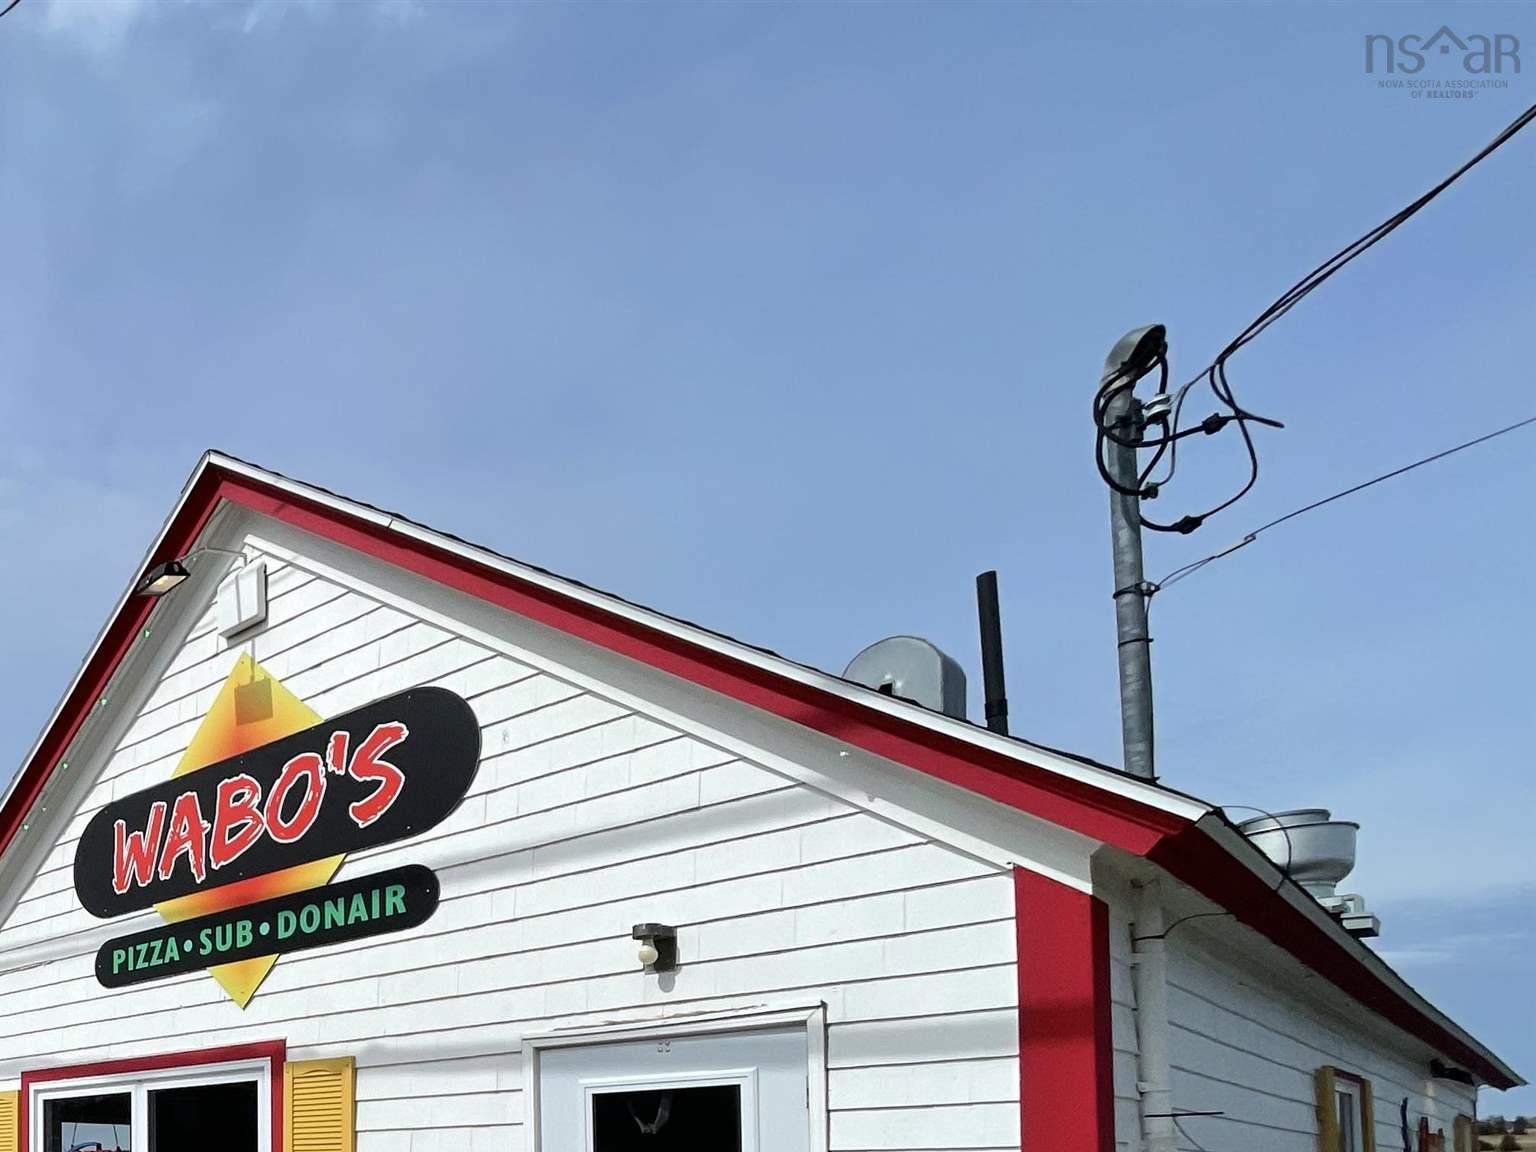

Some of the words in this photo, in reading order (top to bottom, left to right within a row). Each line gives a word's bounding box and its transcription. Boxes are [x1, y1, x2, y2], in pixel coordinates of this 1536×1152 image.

[112, 721, 410, 895] WABO'S
[112, 936, 181, 975] PIZZA
[199, 920, 254, 956] SUB
[277, 884, 408, 941] DONAIR
